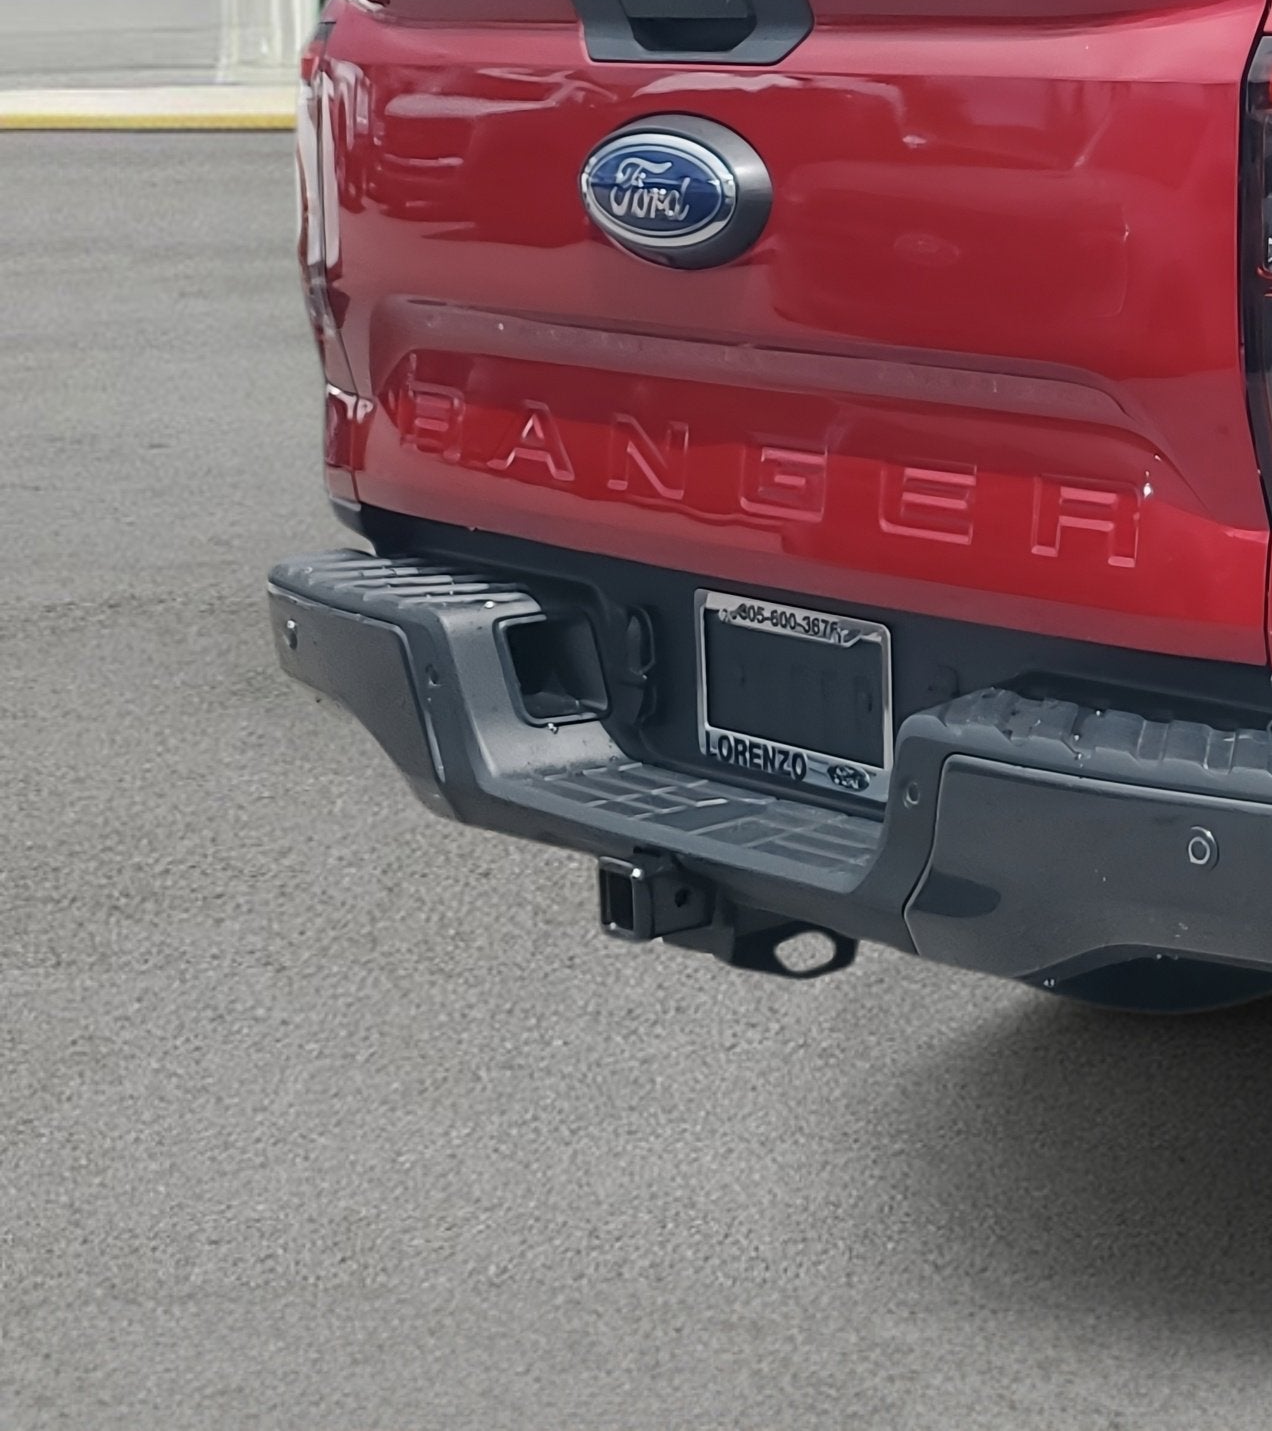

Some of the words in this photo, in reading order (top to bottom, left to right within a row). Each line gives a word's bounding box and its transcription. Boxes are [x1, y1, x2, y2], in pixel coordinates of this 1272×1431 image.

[609, 157, 691, 221] Ford
[402, 380, 1142, 568] RANGER
[705, 730, 808, 782] LORENZO
